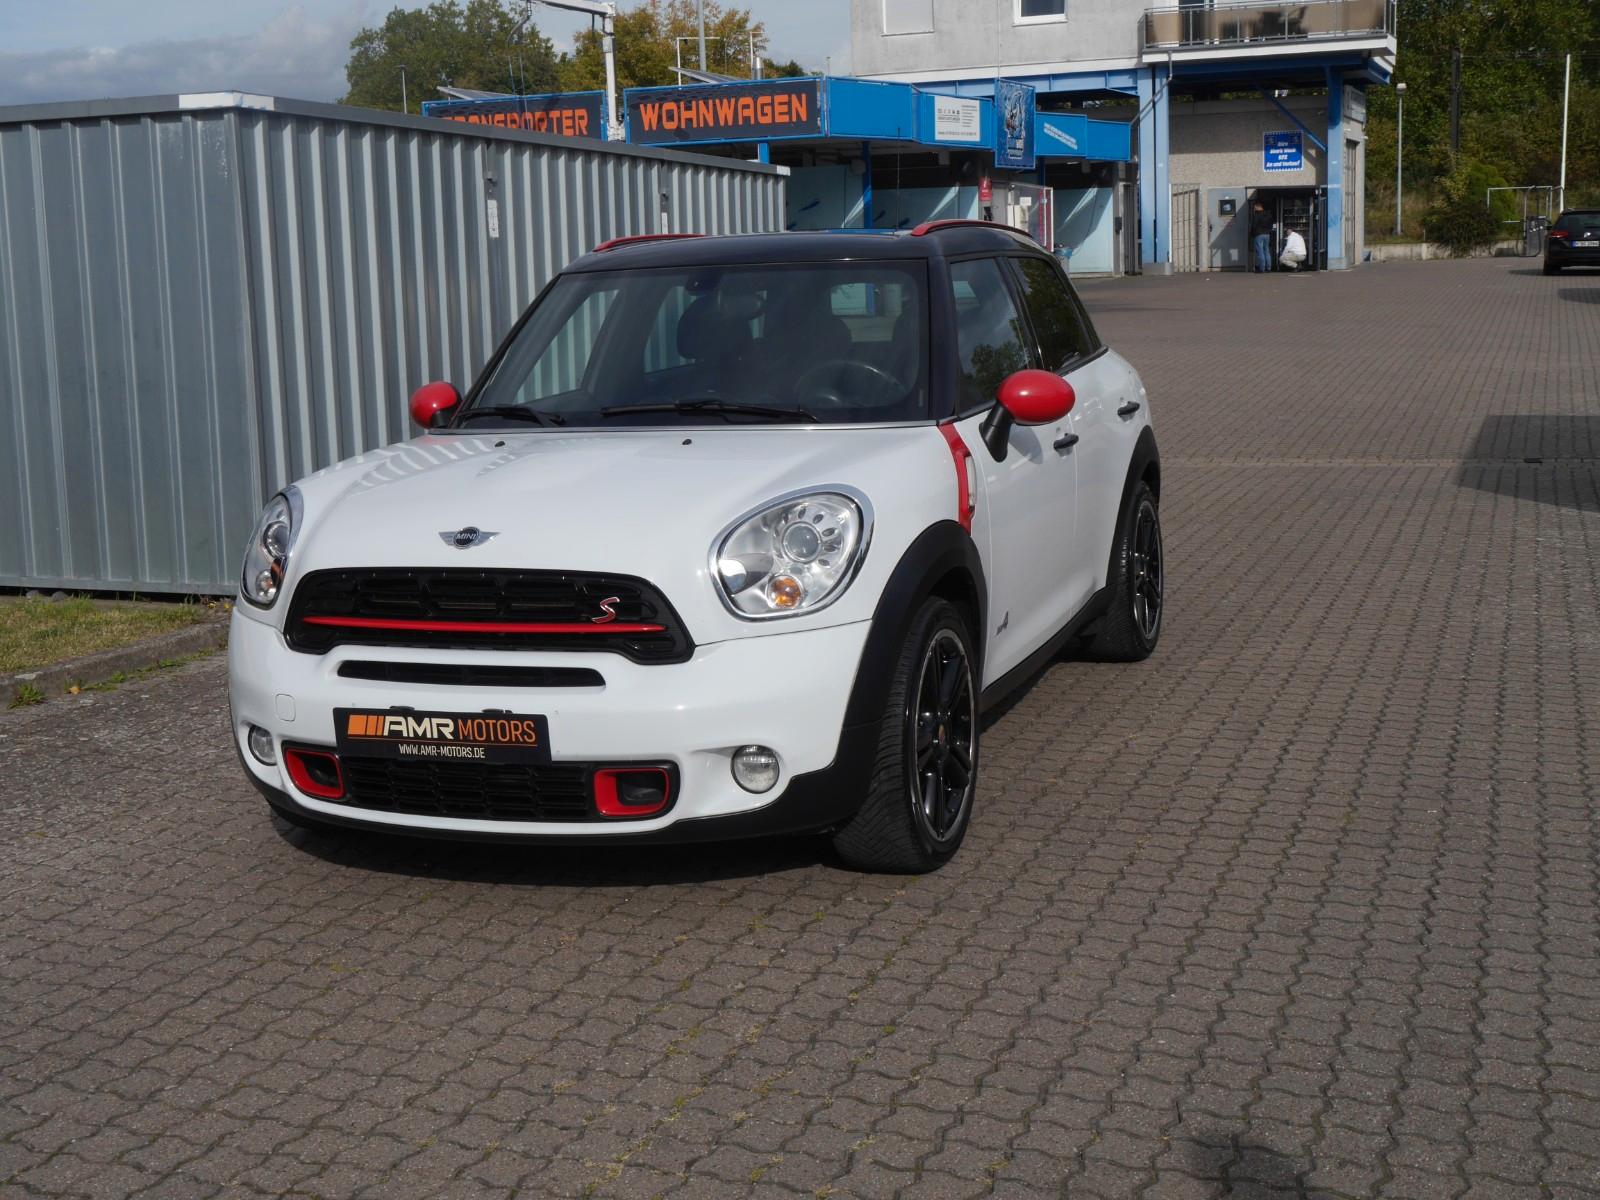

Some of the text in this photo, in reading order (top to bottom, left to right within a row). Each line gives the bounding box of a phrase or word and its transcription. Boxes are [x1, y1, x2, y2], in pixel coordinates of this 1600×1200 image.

[440, 108, 589, 136] SPORTER
[639, 93, 808, 131] WOHNWAGEN
[455, 532, 477, 540] MINI
[591, 596, 621, 624] S
[383, 715, 537, 743] AMR MOTORS
[398, 743, 486, 759] WWW.AMR-MOTORS.DE
